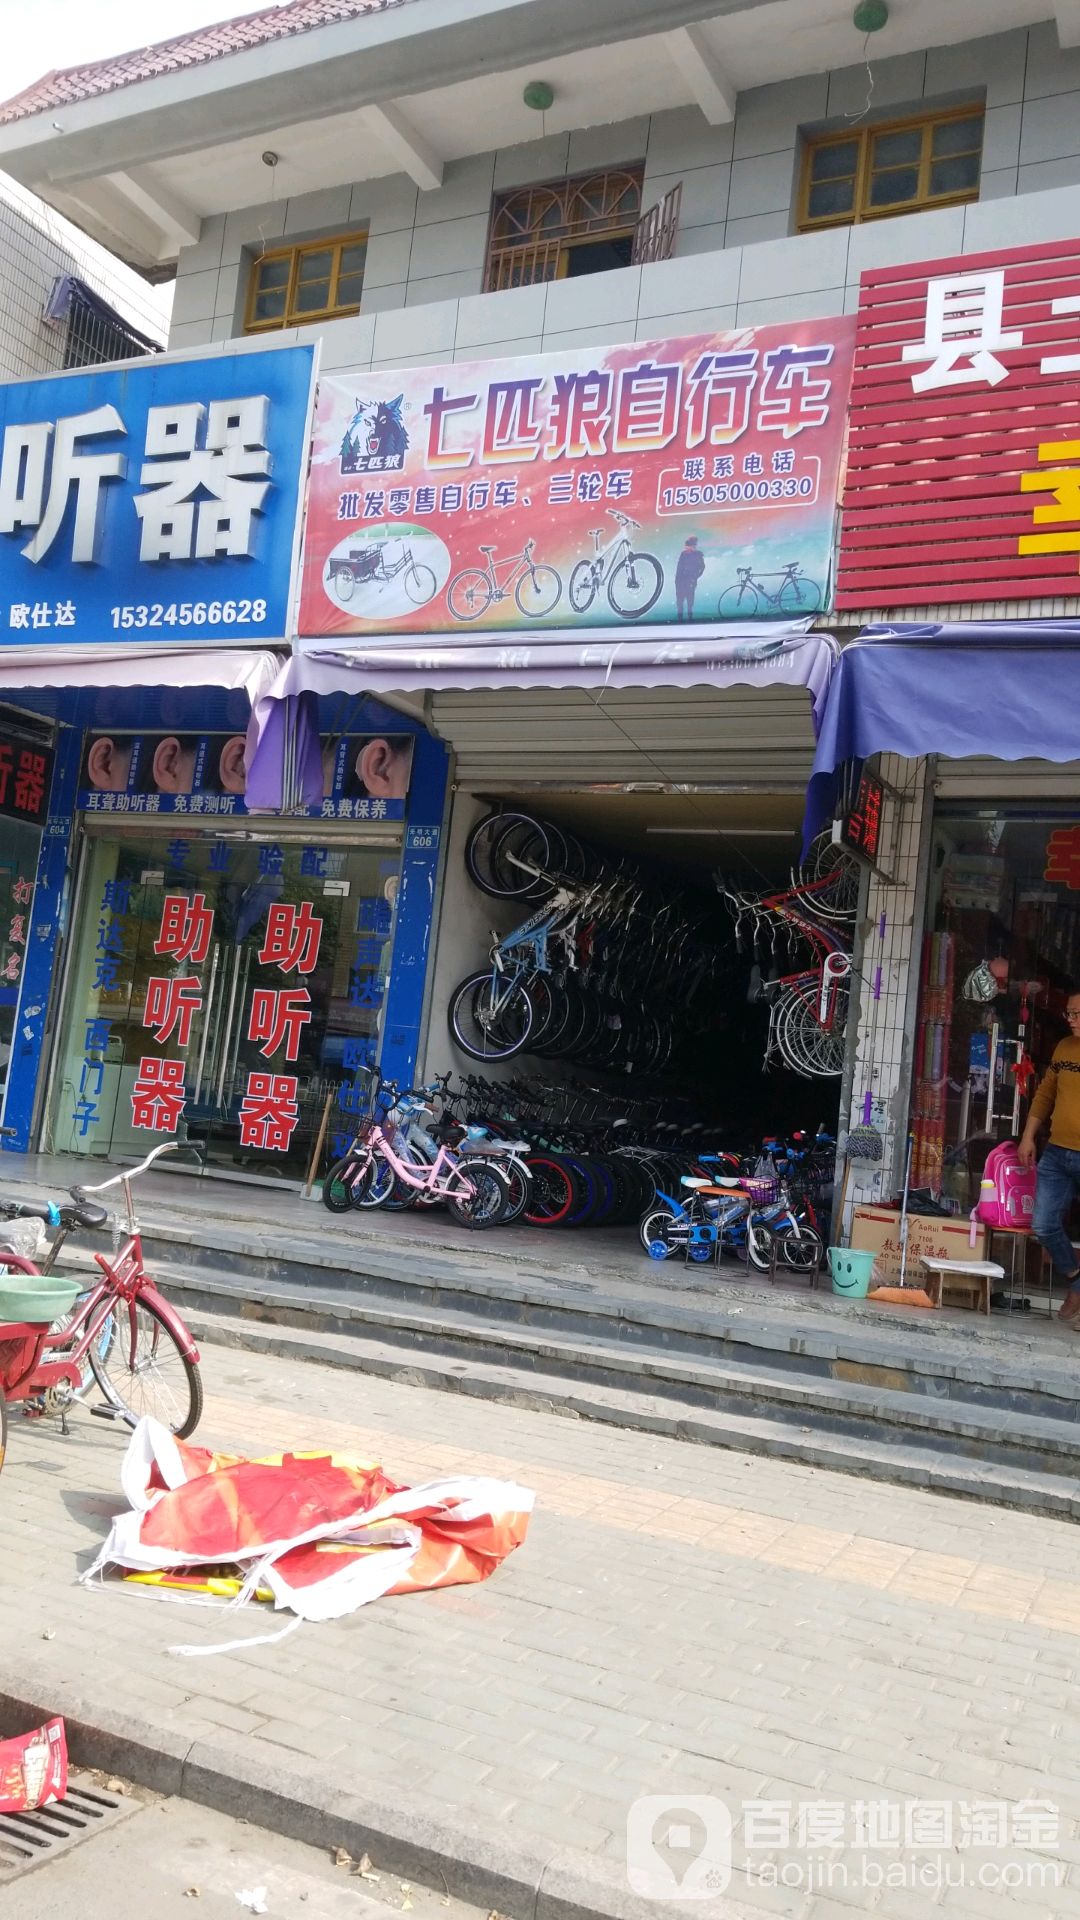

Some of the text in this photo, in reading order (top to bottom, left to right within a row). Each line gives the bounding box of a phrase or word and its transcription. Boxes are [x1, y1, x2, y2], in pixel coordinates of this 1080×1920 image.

[423, 343, 835, 470] 七匹狼自行车
[354, 453, 401, 471] 七匹狼
[683, 450, 795, 482] 联系电话
[0, 395, 272, 564] 听器
[337, 469, 633, 520] 批发零售自行车、三轮车
[661, 477, 814, 508] 15505000330
[9, 600, 77, 629] 欧仕达
[110, 599, 267, 628] 15324566628
[86, 793, 160, 812] 耳聋助听器
[173, 795, 236, 814] 免费测听
[320, 798, 387, 819] 免费保养
[50, 825, 65, 835] 604
[413, 836, 433, 847] 606
[167, 840, 328, 877] 专业验配
[92, 879, 133, 992] 斯达克
[131, 894, 216, 1133] 助听器
[238, 902, 324, 1152] 助听器
[72, 1017, 113, 1137] 西门子
